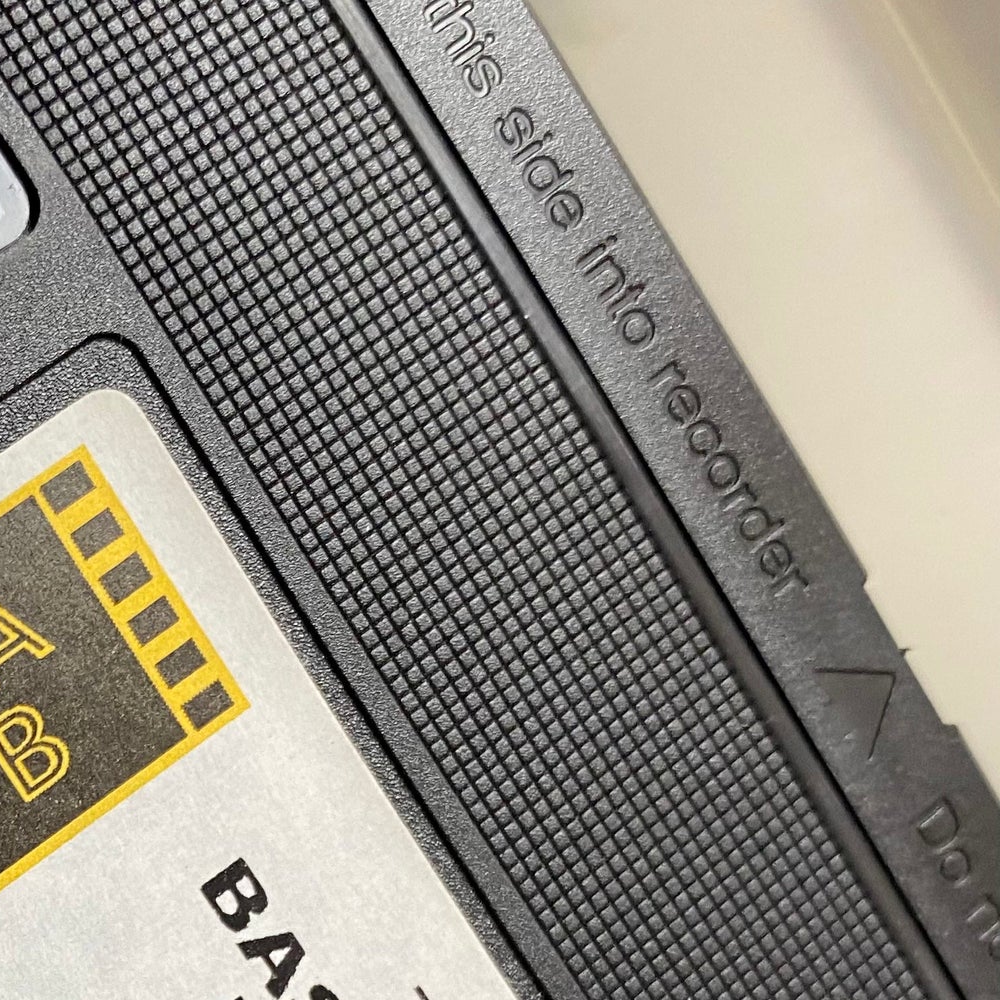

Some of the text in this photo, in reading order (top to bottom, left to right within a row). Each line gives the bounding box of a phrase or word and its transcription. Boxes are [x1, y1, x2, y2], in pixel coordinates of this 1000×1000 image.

[423, 0, 809, 598] this side into recorder
[916, 796, 971, 888] Do
